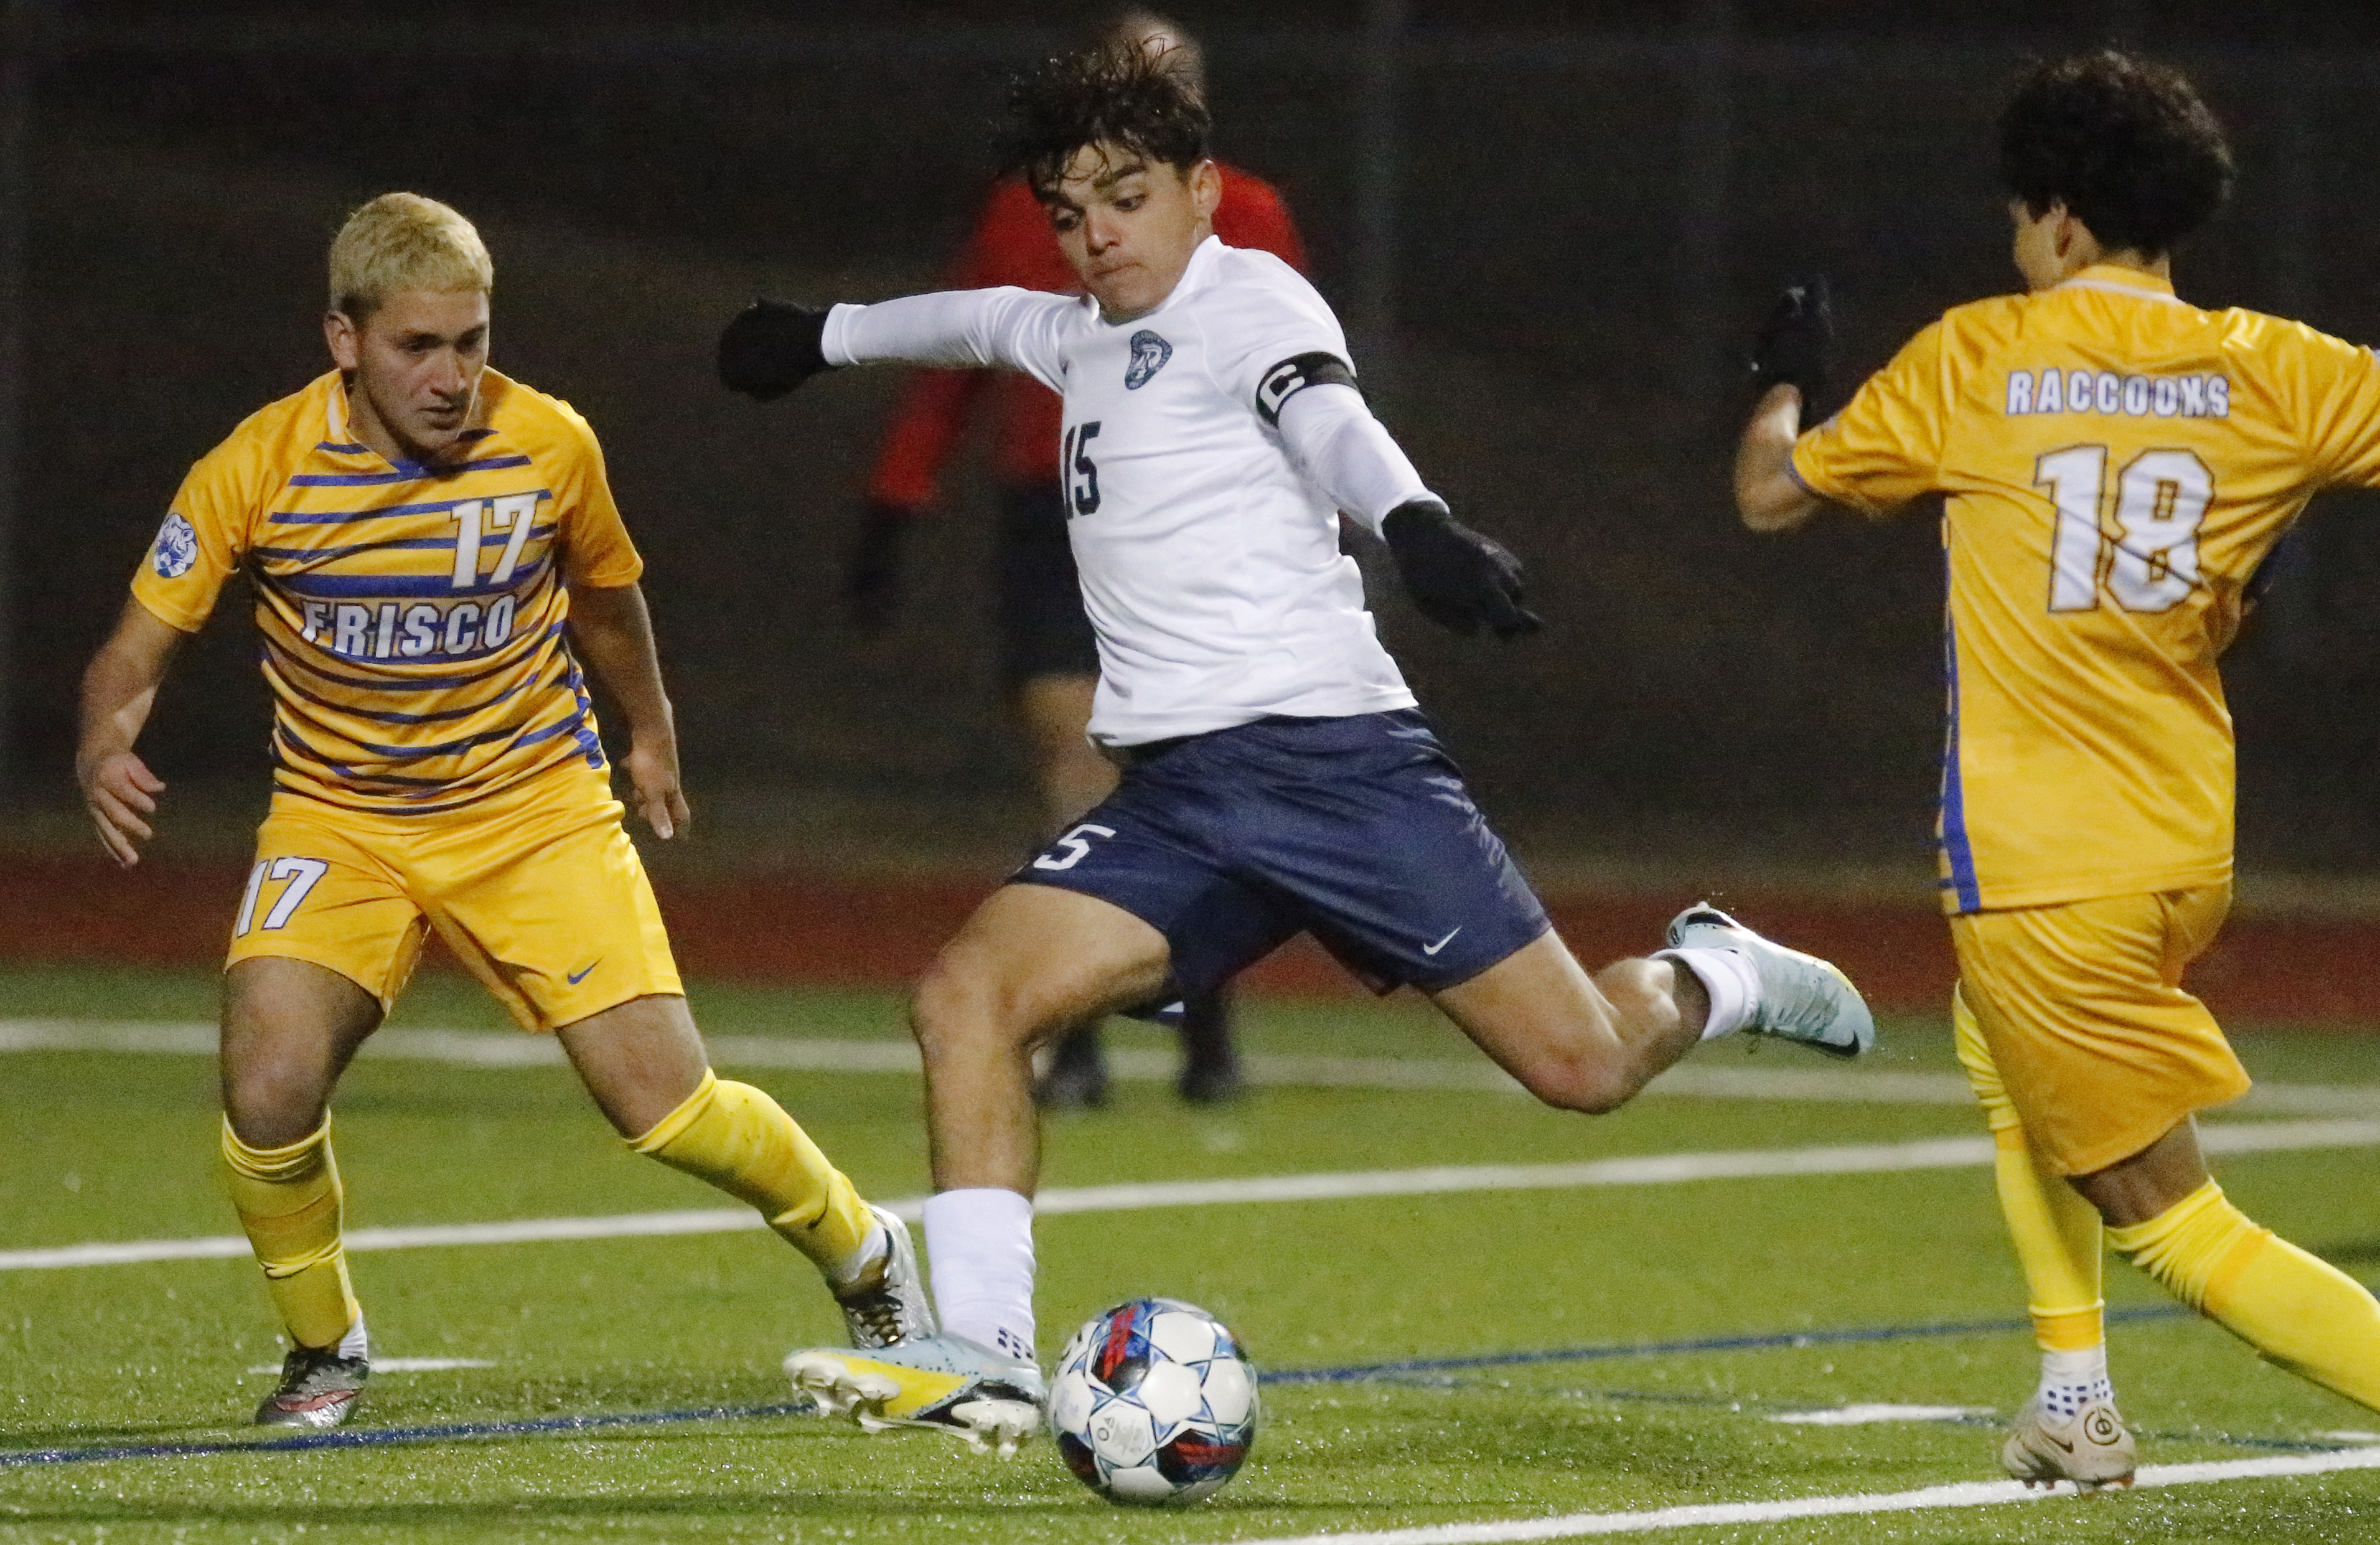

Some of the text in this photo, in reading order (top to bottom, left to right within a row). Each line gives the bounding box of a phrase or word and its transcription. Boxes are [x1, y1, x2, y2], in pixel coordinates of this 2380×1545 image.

[1260, 364, 1306, 413] C
[2007, 369, 2229, 417] RACCOONS
[1064, 421, 1102, 519] 15
[451, 492, 539, 588] 17
[2033, 441, 2216, 613] 18
[302, 594, 516, 659] FRISCO
[237, 857, 329, 939] 17
